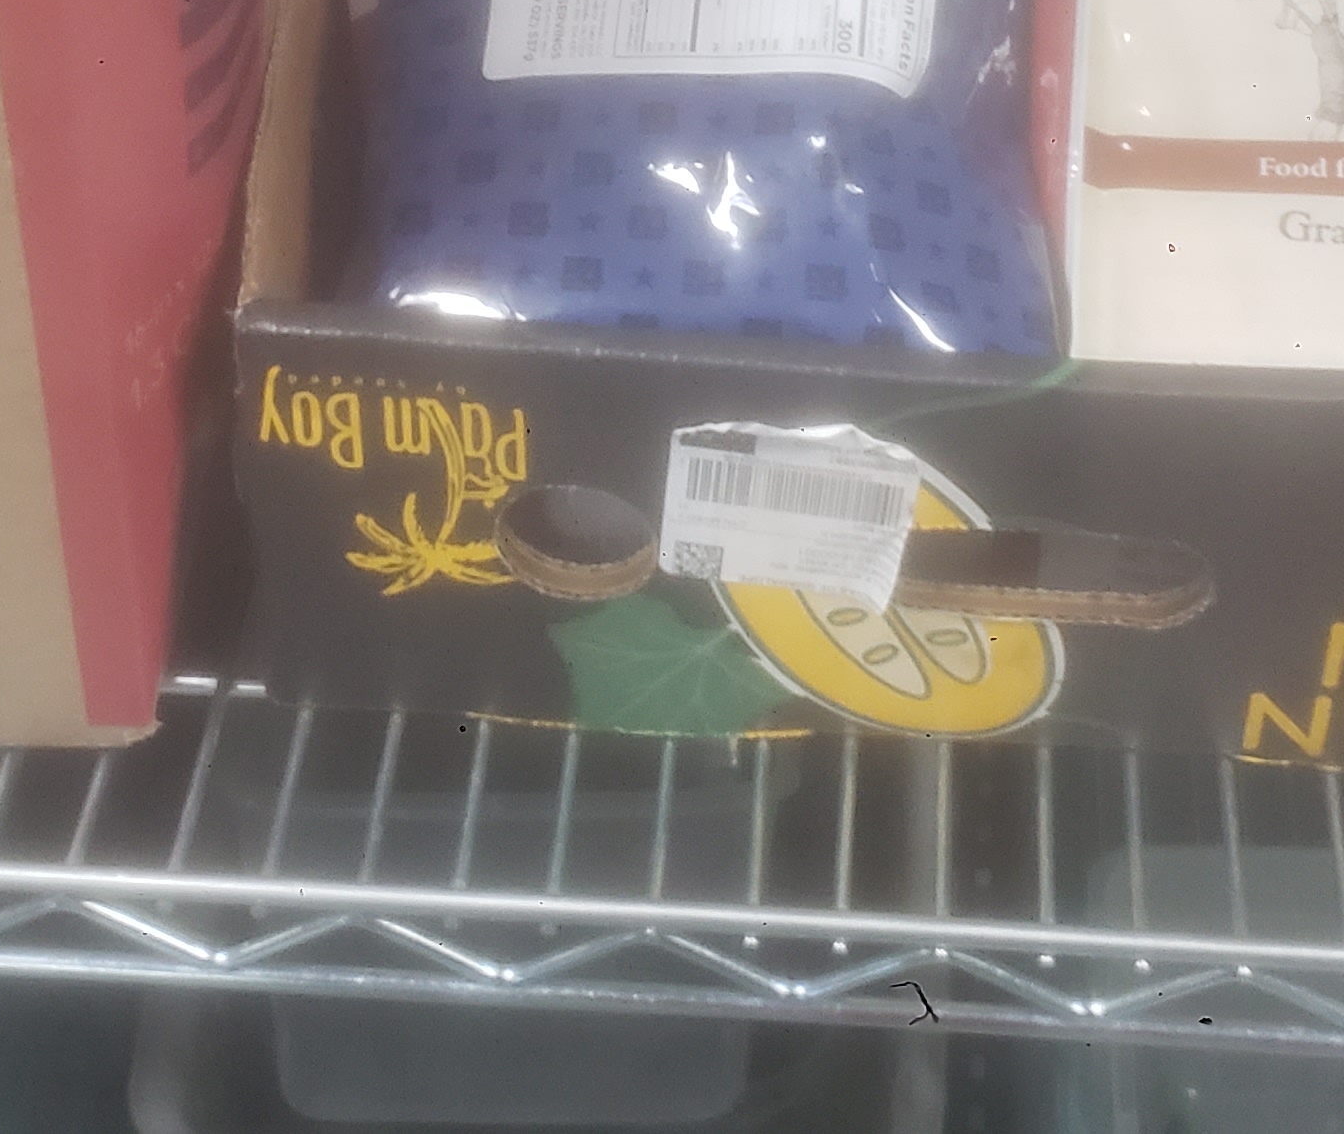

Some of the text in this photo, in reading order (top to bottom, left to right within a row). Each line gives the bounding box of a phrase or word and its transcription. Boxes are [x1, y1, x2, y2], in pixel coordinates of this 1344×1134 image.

[836, 18, 853, 55] 300
[898, 18, 915, 71] Facts
[1258, 155, 1329, 181] Food
[259, 365, 527, 483] Palm Boy
